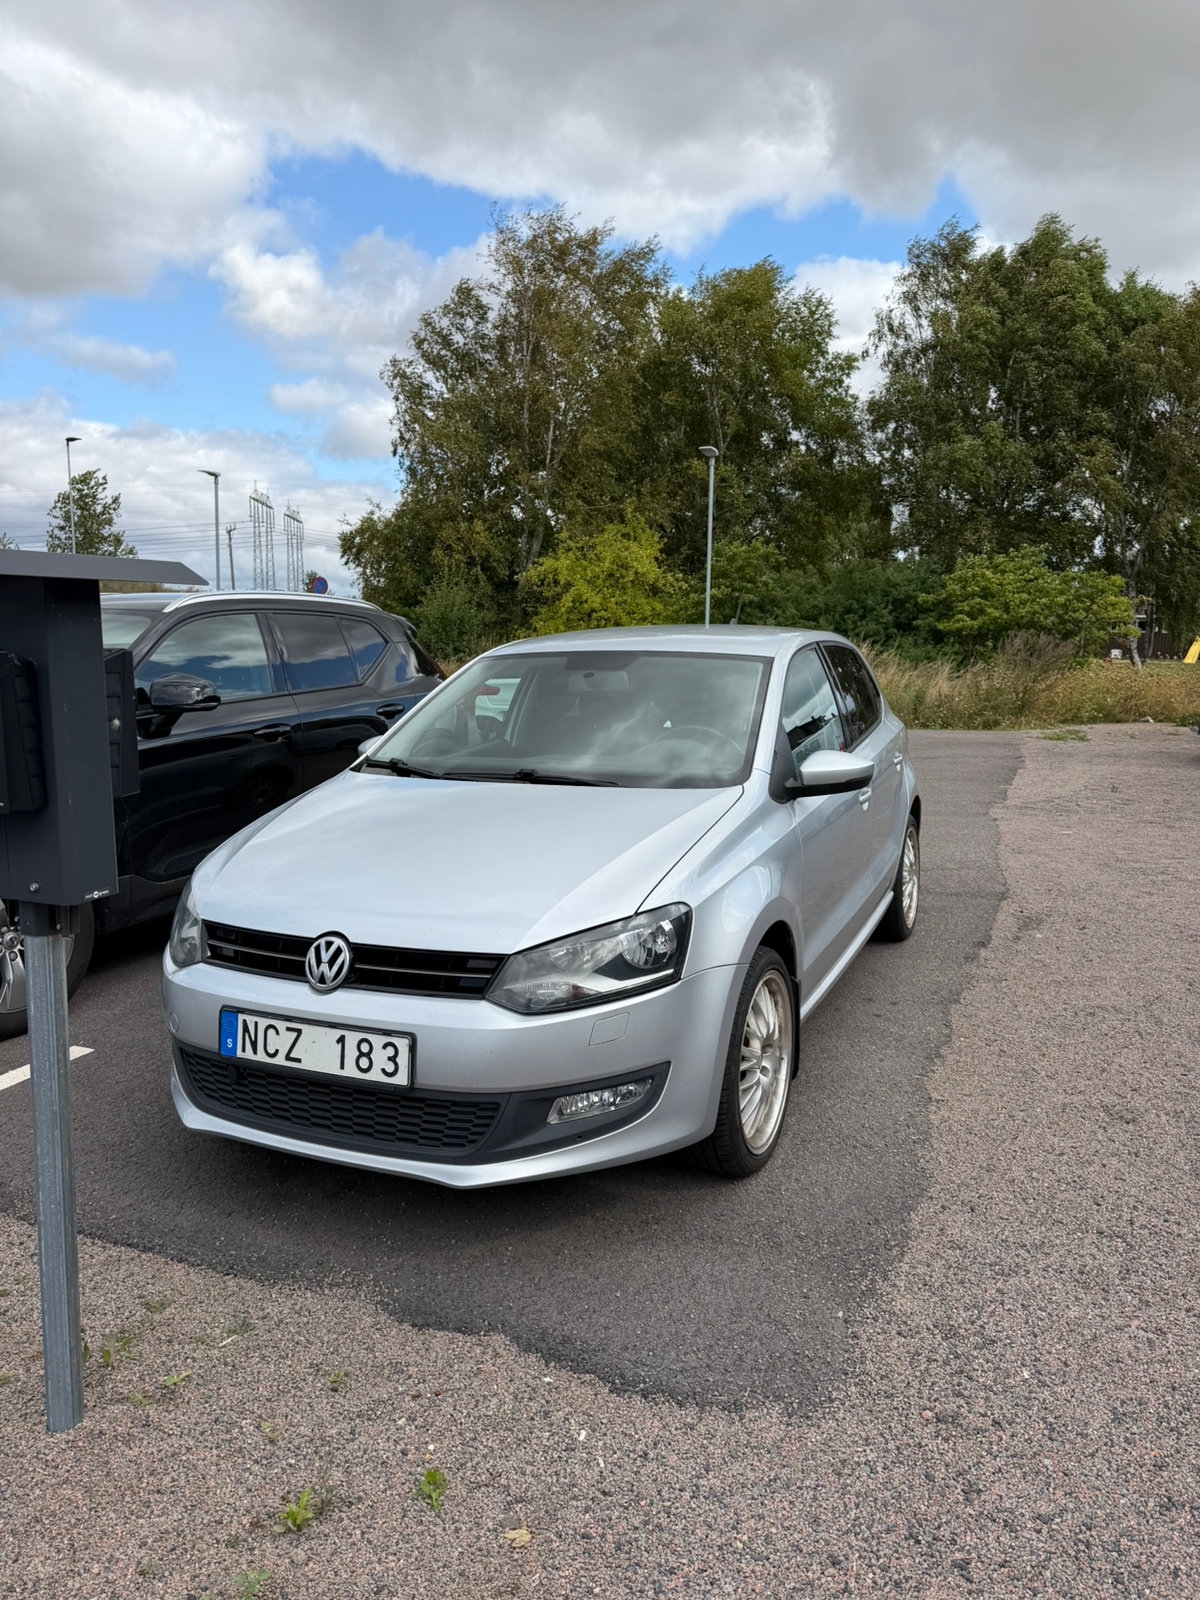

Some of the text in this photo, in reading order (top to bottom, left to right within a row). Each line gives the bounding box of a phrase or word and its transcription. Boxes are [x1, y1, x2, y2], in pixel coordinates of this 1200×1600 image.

[226, 1038, 233, 1048] S
[241, 1018, 400, 1078] NCZ 183
